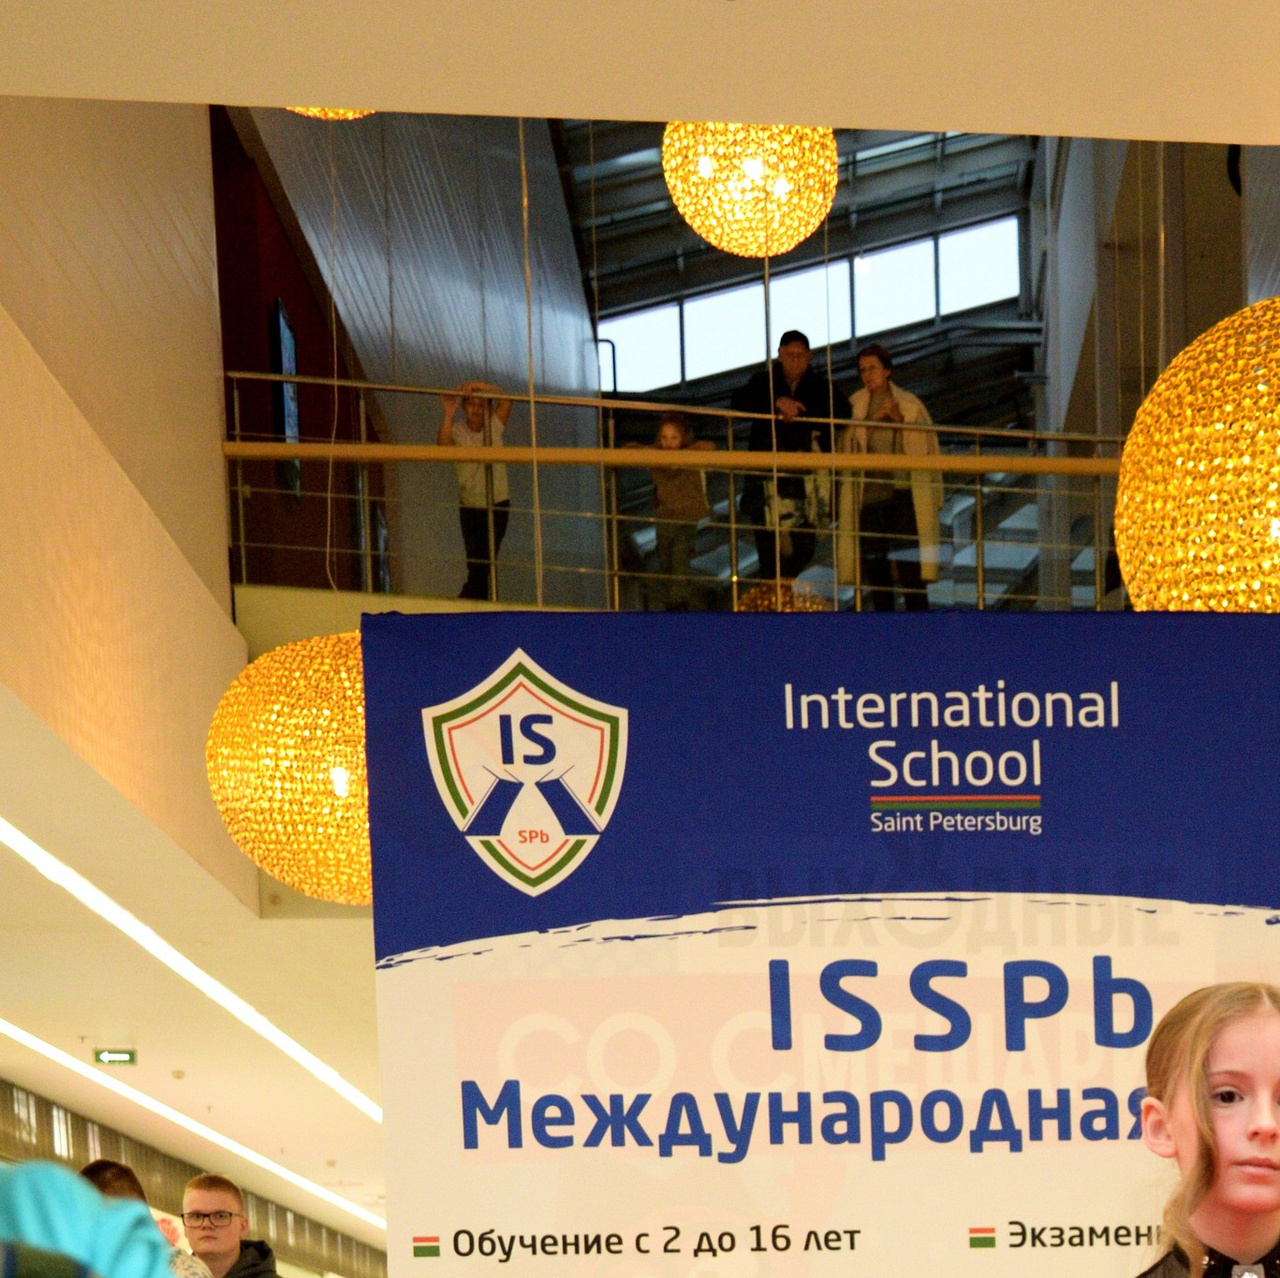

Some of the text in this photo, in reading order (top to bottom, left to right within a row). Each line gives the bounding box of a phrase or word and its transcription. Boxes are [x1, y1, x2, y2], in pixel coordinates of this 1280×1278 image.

[785, 680, 1120, 730] International
[499, 714, 556, 765] IS
[867, 738, 1042, 788] School
[517, 829, 550, 844] SPb
[870, 811, 1042, 836] Saint Petersburg
[770, 956, 1154, 1052] ISSPb
[453, 1224, 861, 1263] Обучение с 2 до 16 лет
